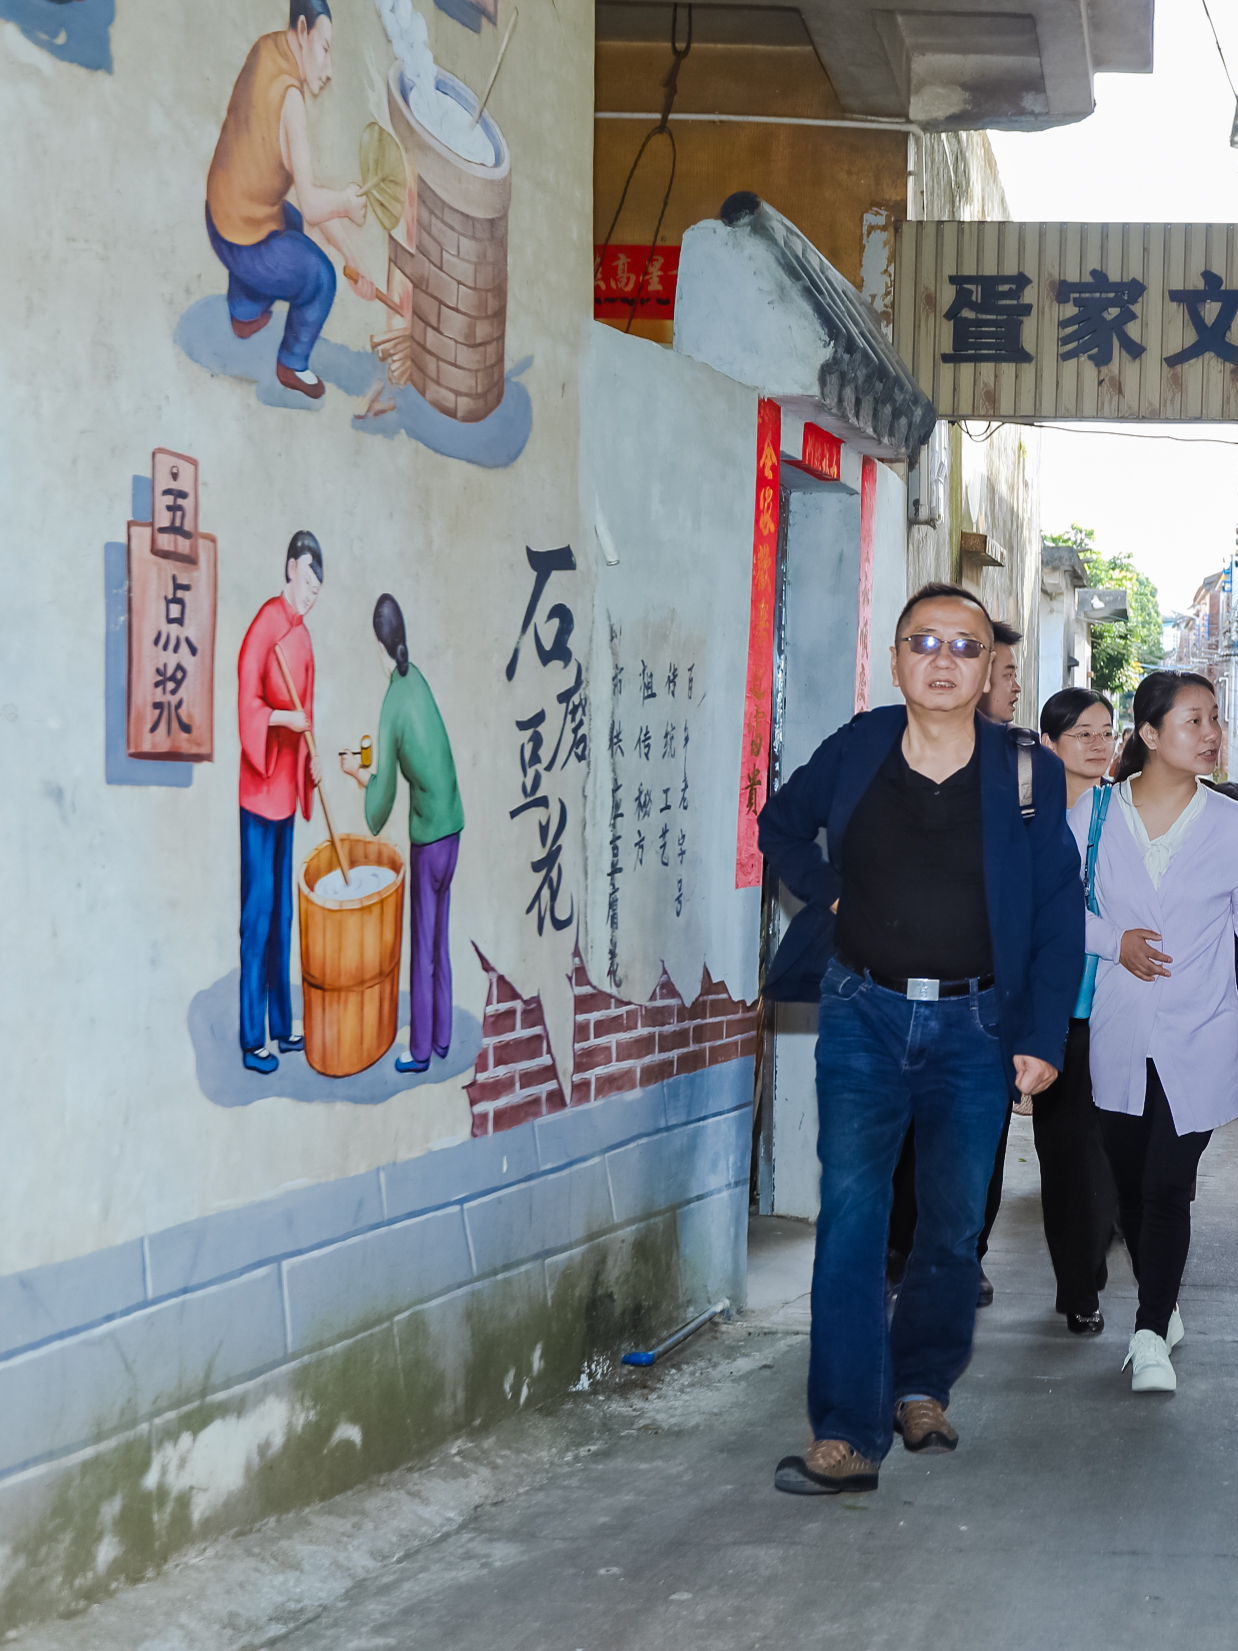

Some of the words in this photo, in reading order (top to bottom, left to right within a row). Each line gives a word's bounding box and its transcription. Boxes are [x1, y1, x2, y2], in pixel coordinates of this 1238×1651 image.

[157, 487, 194, 540] 五
[149, 573, 198, 737] 点浆
[634, 659, 657, 873] 祖传秘方
